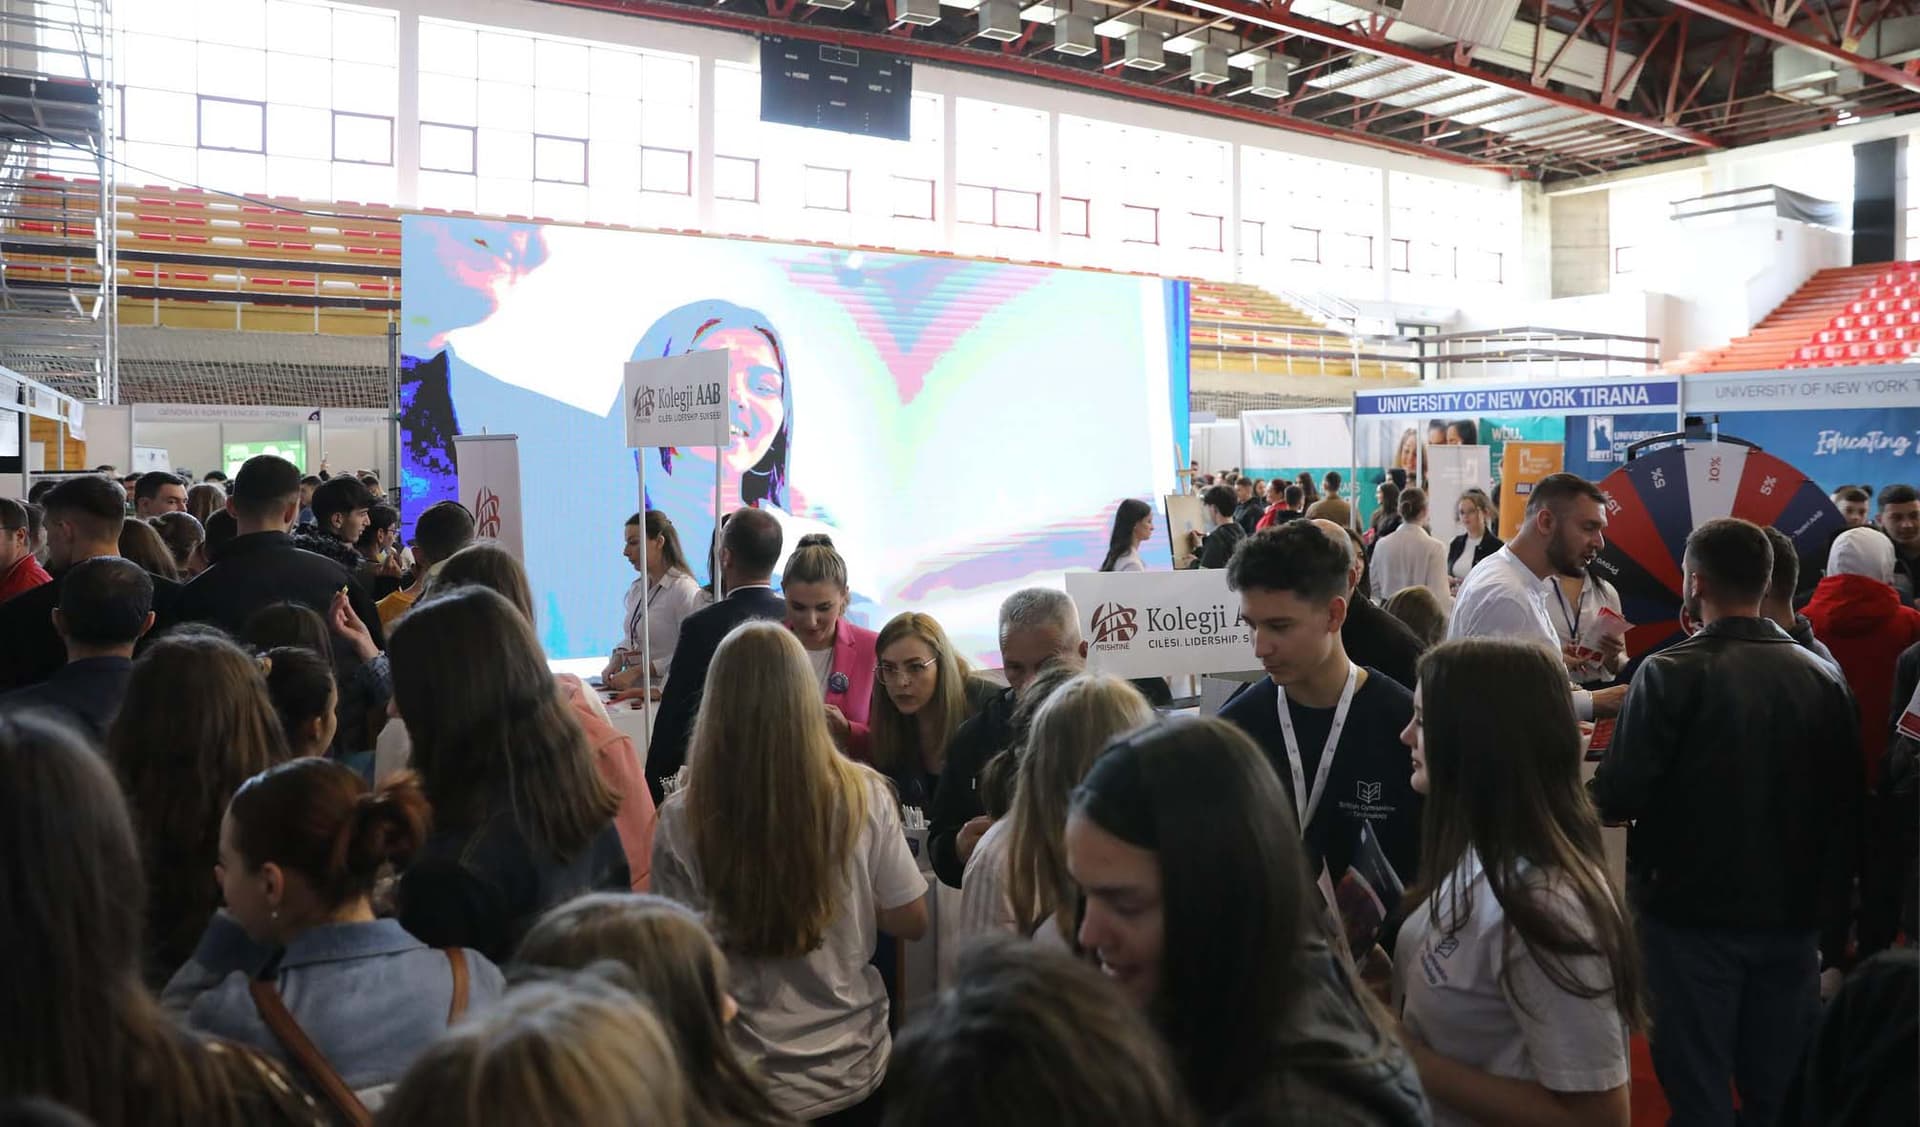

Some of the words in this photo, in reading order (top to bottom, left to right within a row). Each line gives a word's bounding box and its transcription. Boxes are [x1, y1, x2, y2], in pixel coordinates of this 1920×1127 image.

[658, 386, 693, 412] Kolegji
[696, 382, 721, 406] AAB
[1377, 394, 1462, 413] UNIVERSITY
[1465, 392, 1486, 410] OF
[1488, 390, 1526, 409] NEW
[1529, 388, 1577, 408] YORK
[1579, 385, 1649, 406] TIRANA
[1714, 383, 1797, 399] UNIVERSITY
[1801, 382, 1821, 396] OF
[1825, 380, 1861, 395] NEW
[1864, 378, 1910, 393] YORK
[1253, 424, 1291, 446] wbu.
[1813, 429, 1911, 456] Educating
[1651, 467, 1666, 489] 5%
[1709, 456, 1721, 482] 10%
[1760, 475, 1777, 496] 5%
[1146, 605, 1227, 635] Kolegji
